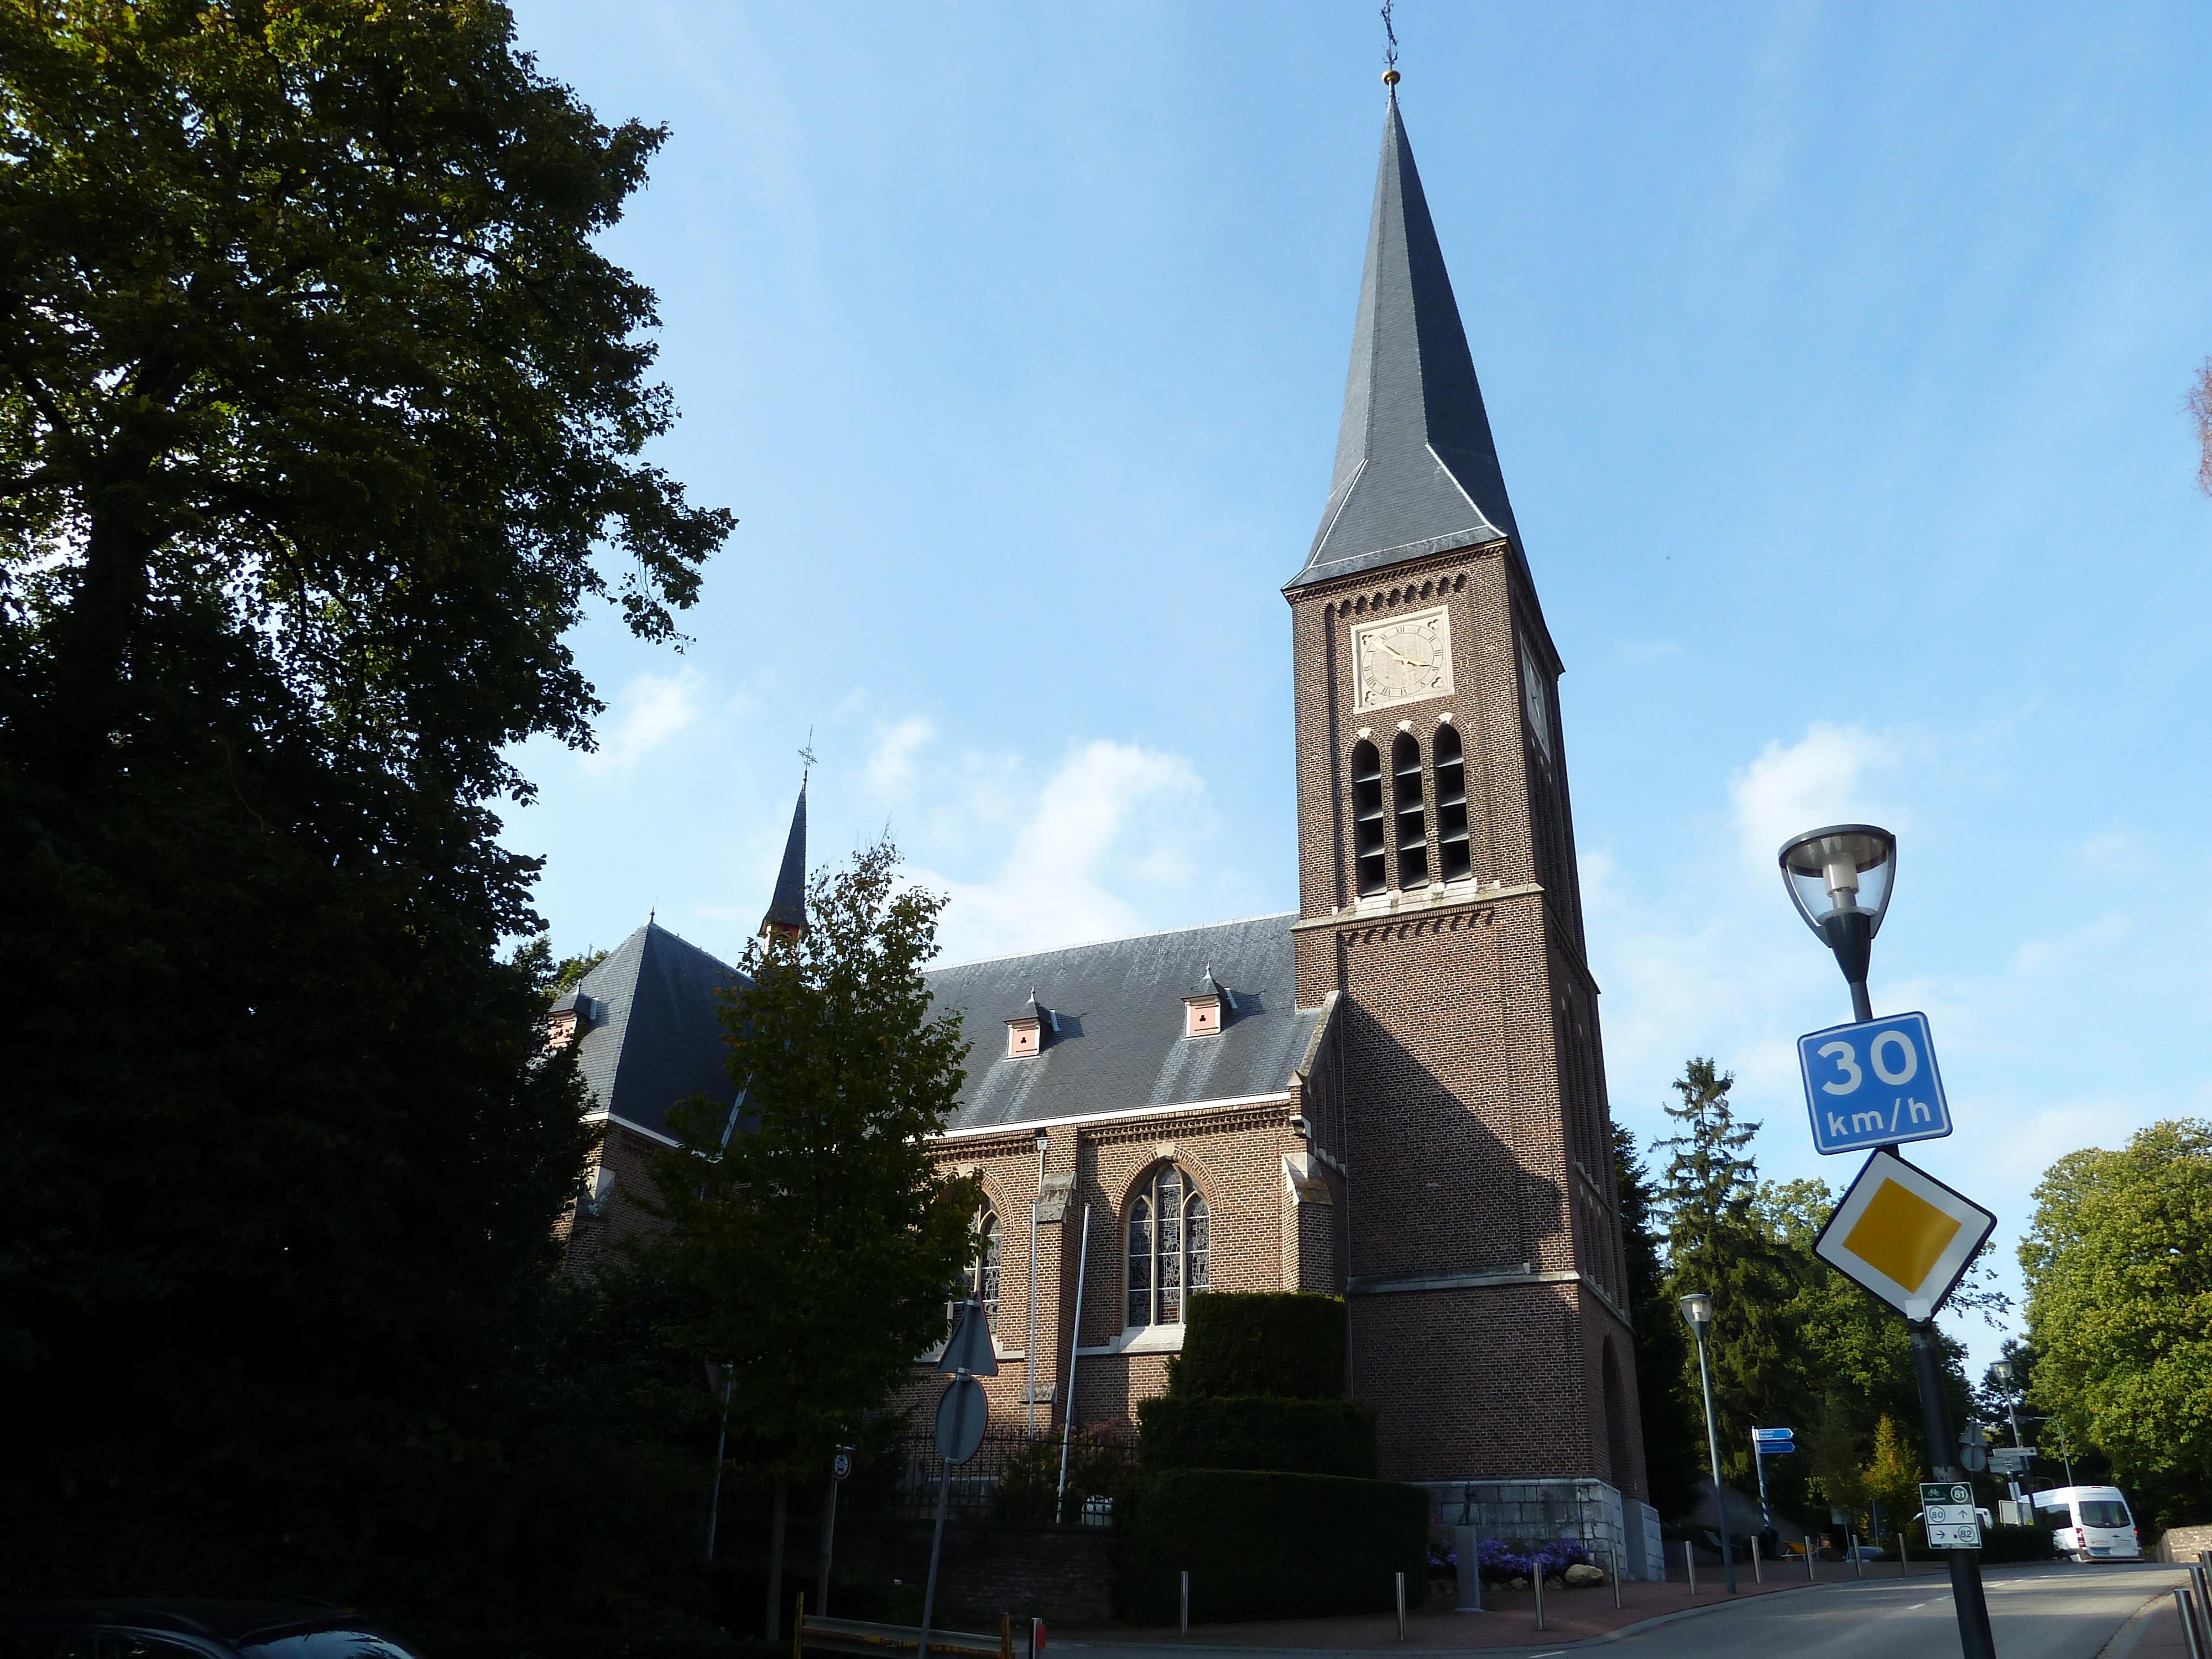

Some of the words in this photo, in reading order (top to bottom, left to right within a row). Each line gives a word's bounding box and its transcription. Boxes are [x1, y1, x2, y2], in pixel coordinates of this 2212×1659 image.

[1817, 1030, 1918, 1096] 30
[1828, 1097, 1931, 1138] km/h
[1960, 1530, 1972, 1538] 82
